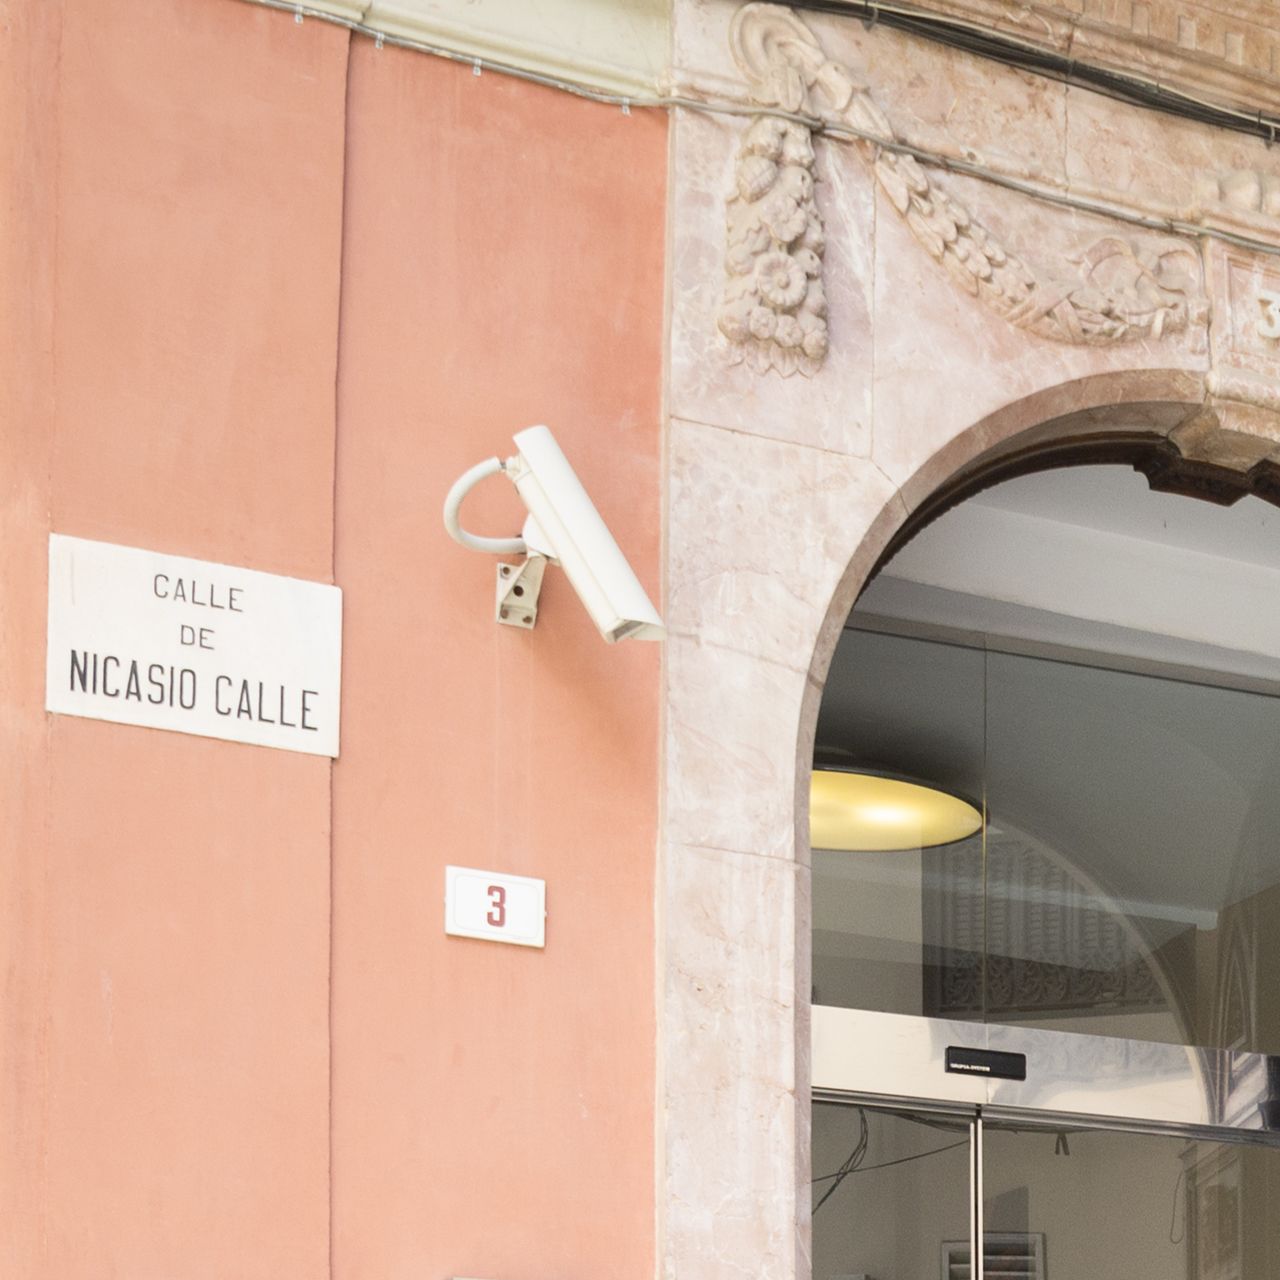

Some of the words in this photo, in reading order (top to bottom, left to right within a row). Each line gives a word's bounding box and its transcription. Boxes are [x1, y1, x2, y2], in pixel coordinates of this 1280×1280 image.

[153, 573, 244, 613] CALLE
[180, 624, 216, 650] DE
[69, 648, 197, 710] NICASIO
[215, 675, 319, 731] CALLE
[487, 885, 506, 928] 3
